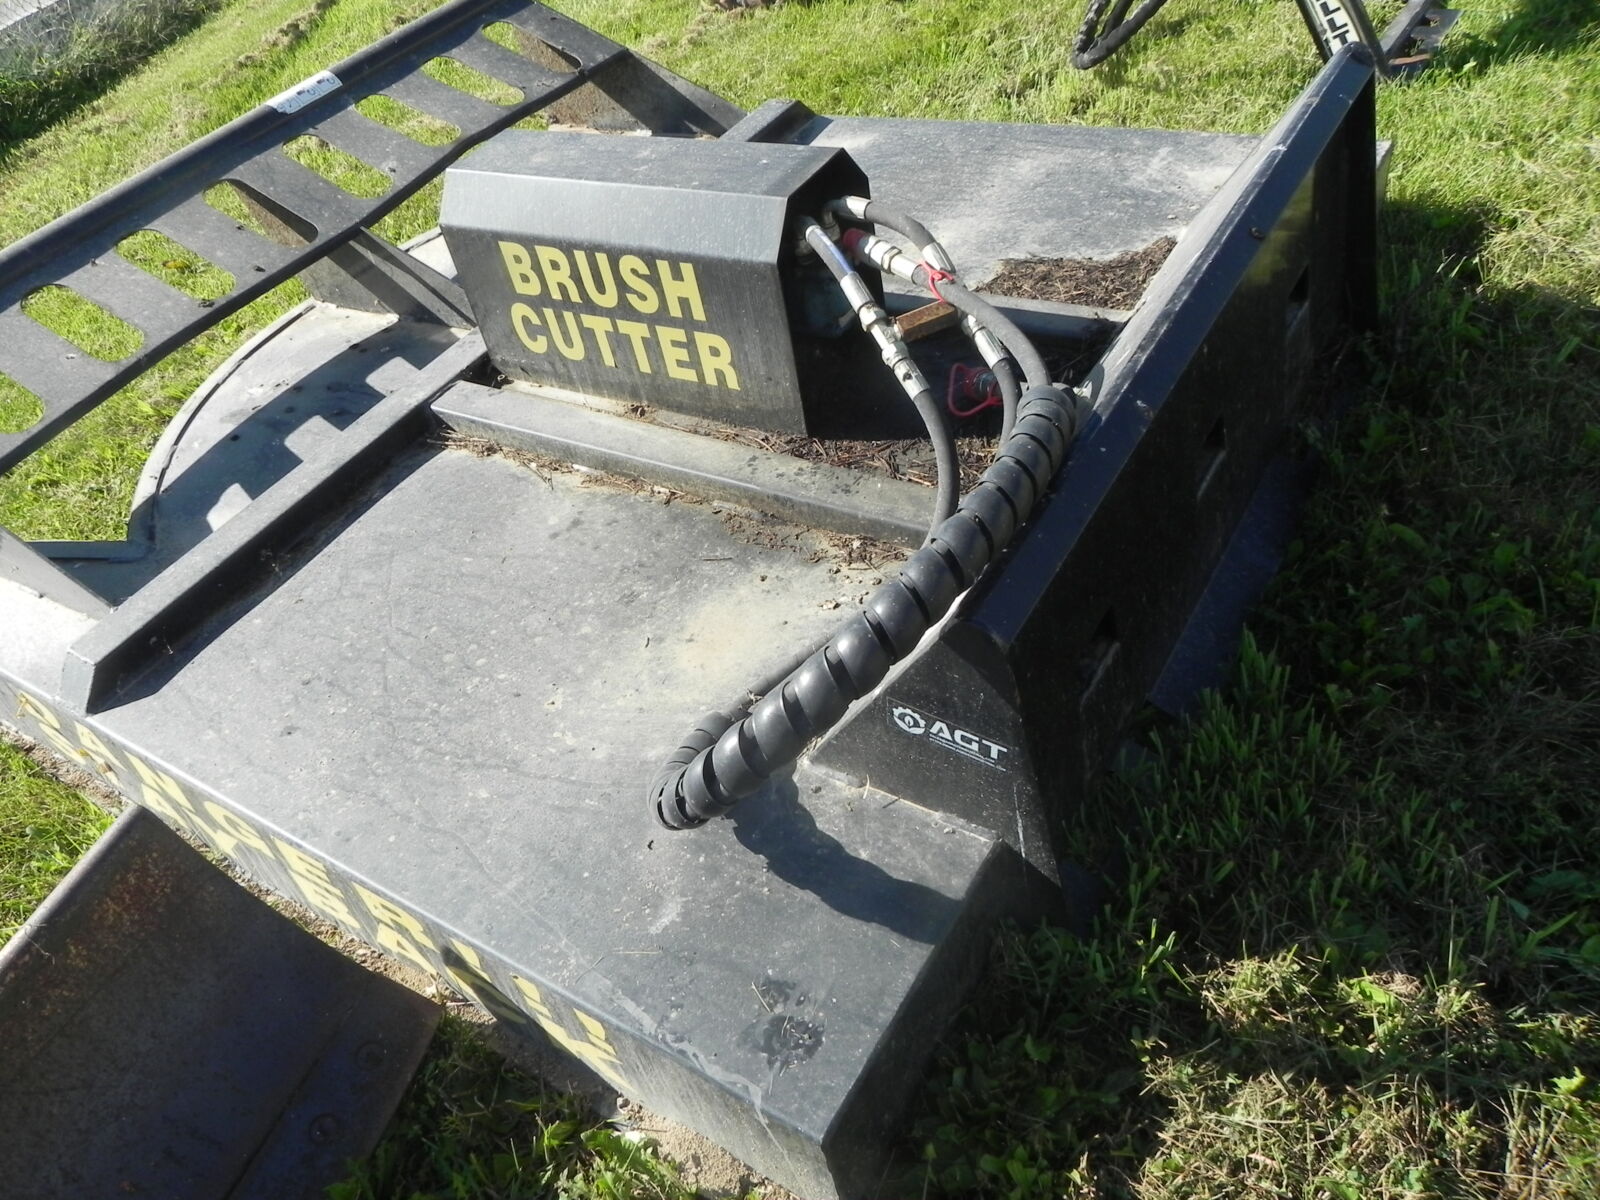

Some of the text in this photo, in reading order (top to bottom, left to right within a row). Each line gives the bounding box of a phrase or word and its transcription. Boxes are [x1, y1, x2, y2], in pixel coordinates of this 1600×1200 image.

[498, 240, 707, 322] BRUSH
[510, 302, 741, 391] CUTTER
[929, 720, 1008, 759] AGT
